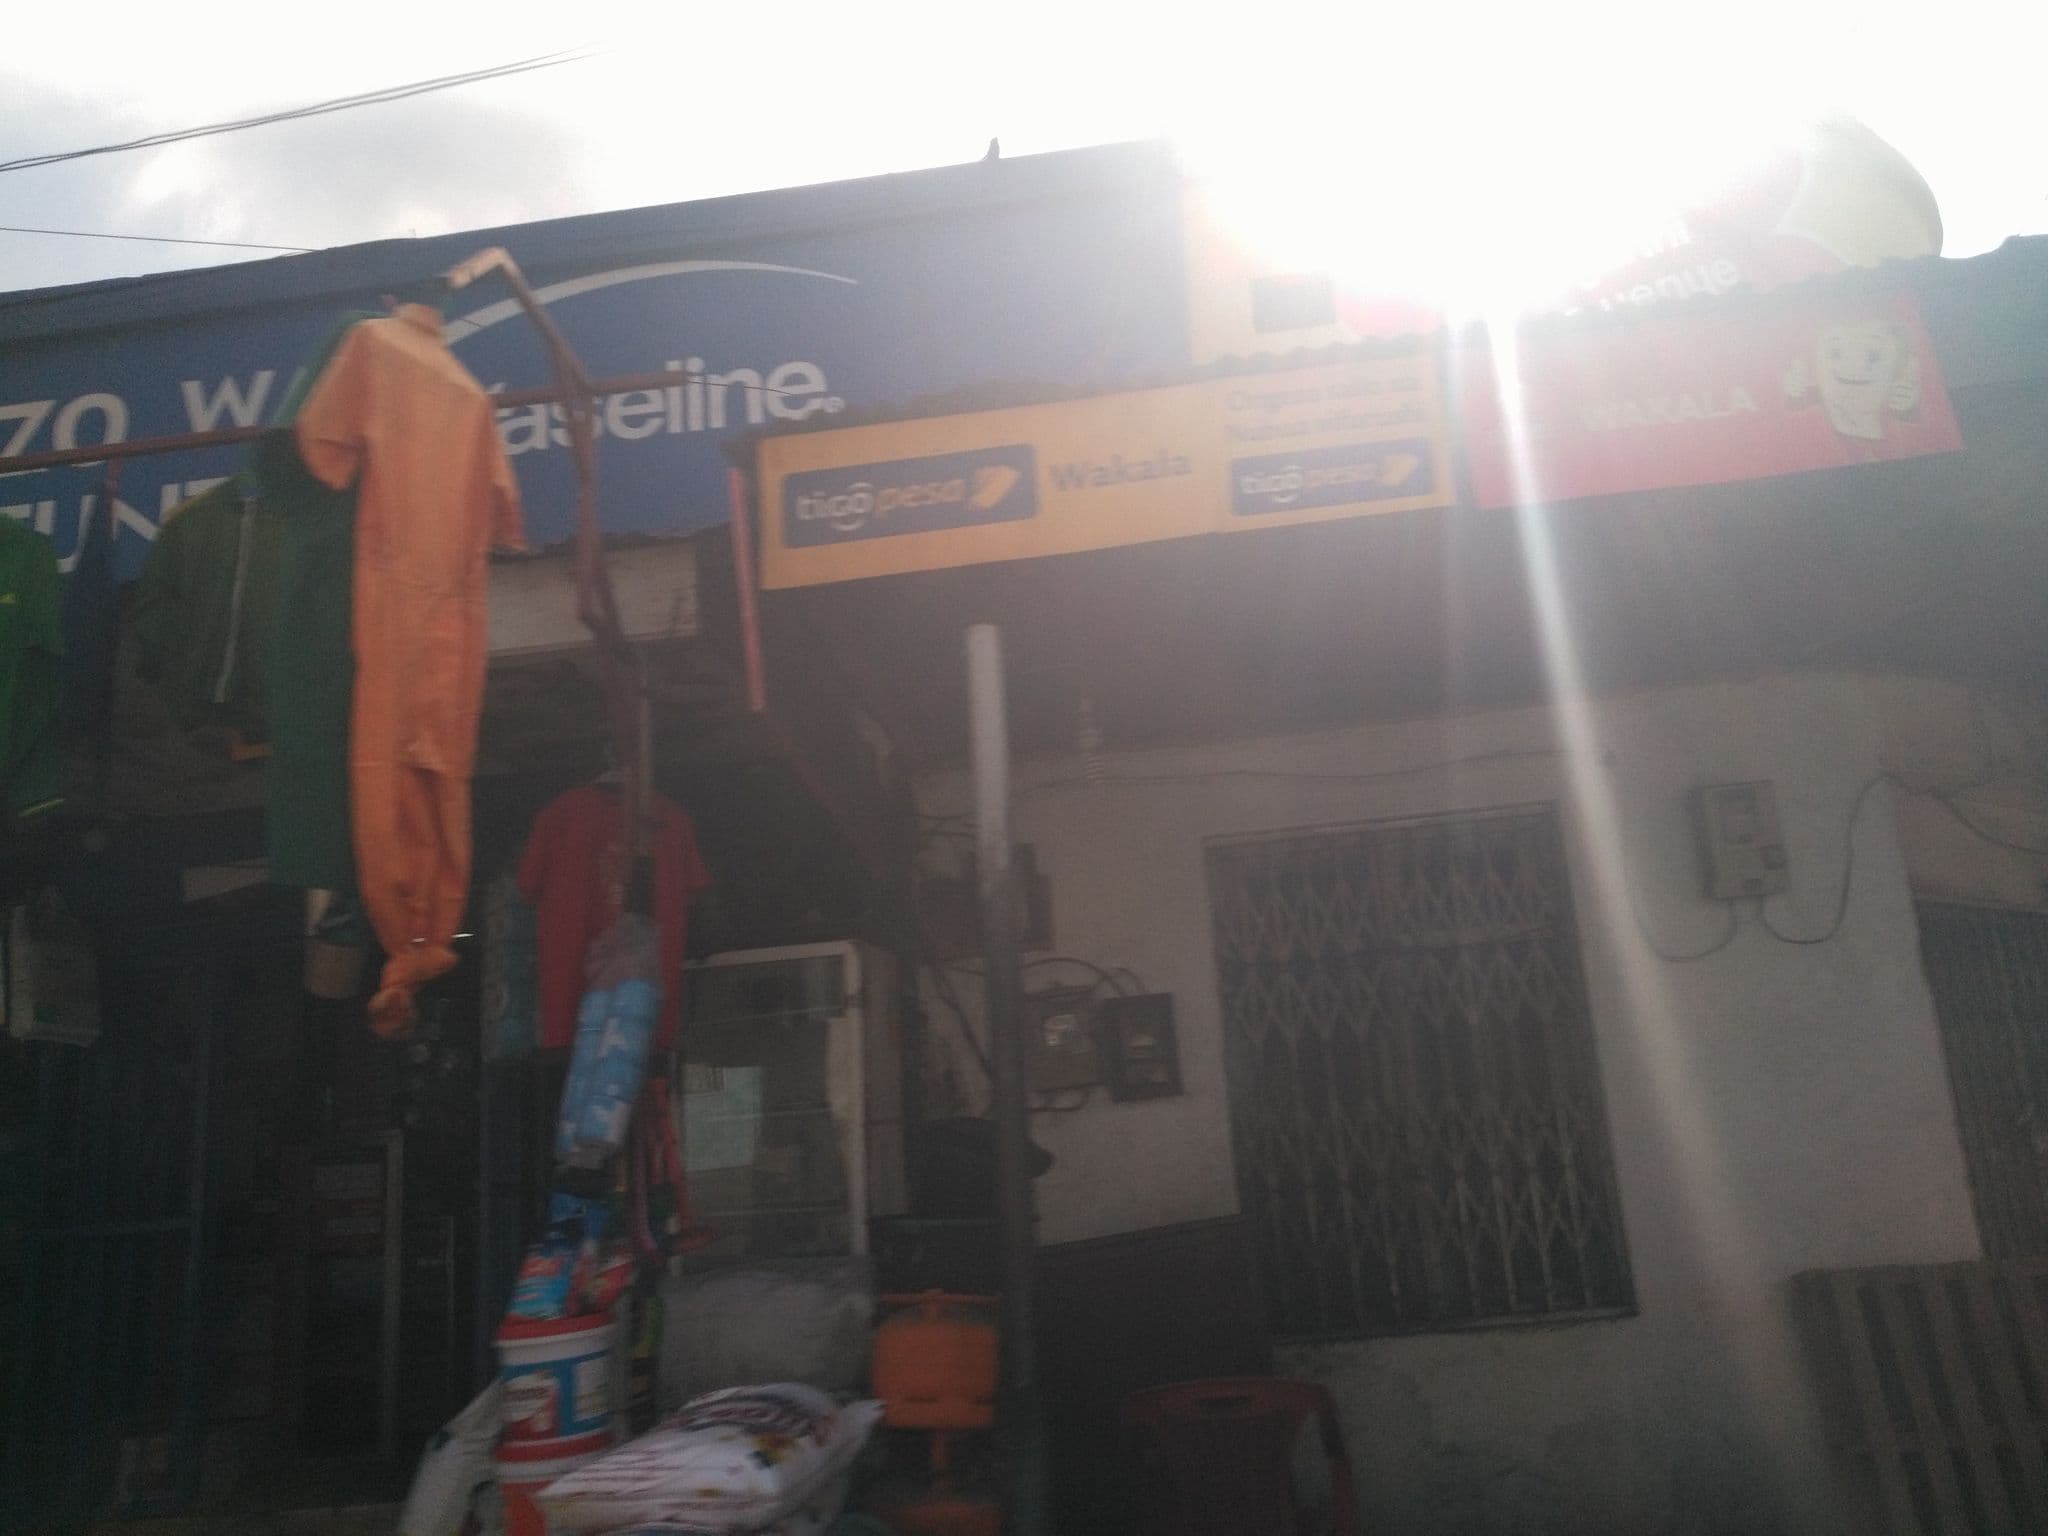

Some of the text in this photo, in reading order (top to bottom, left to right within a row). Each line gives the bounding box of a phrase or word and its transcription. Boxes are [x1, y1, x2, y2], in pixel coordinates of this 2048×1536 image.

[490, 357, 830, 456] aseline
[1581, 386, 1760, 432] WAKALA
[1049, 448, 1192, 492] Wakala
